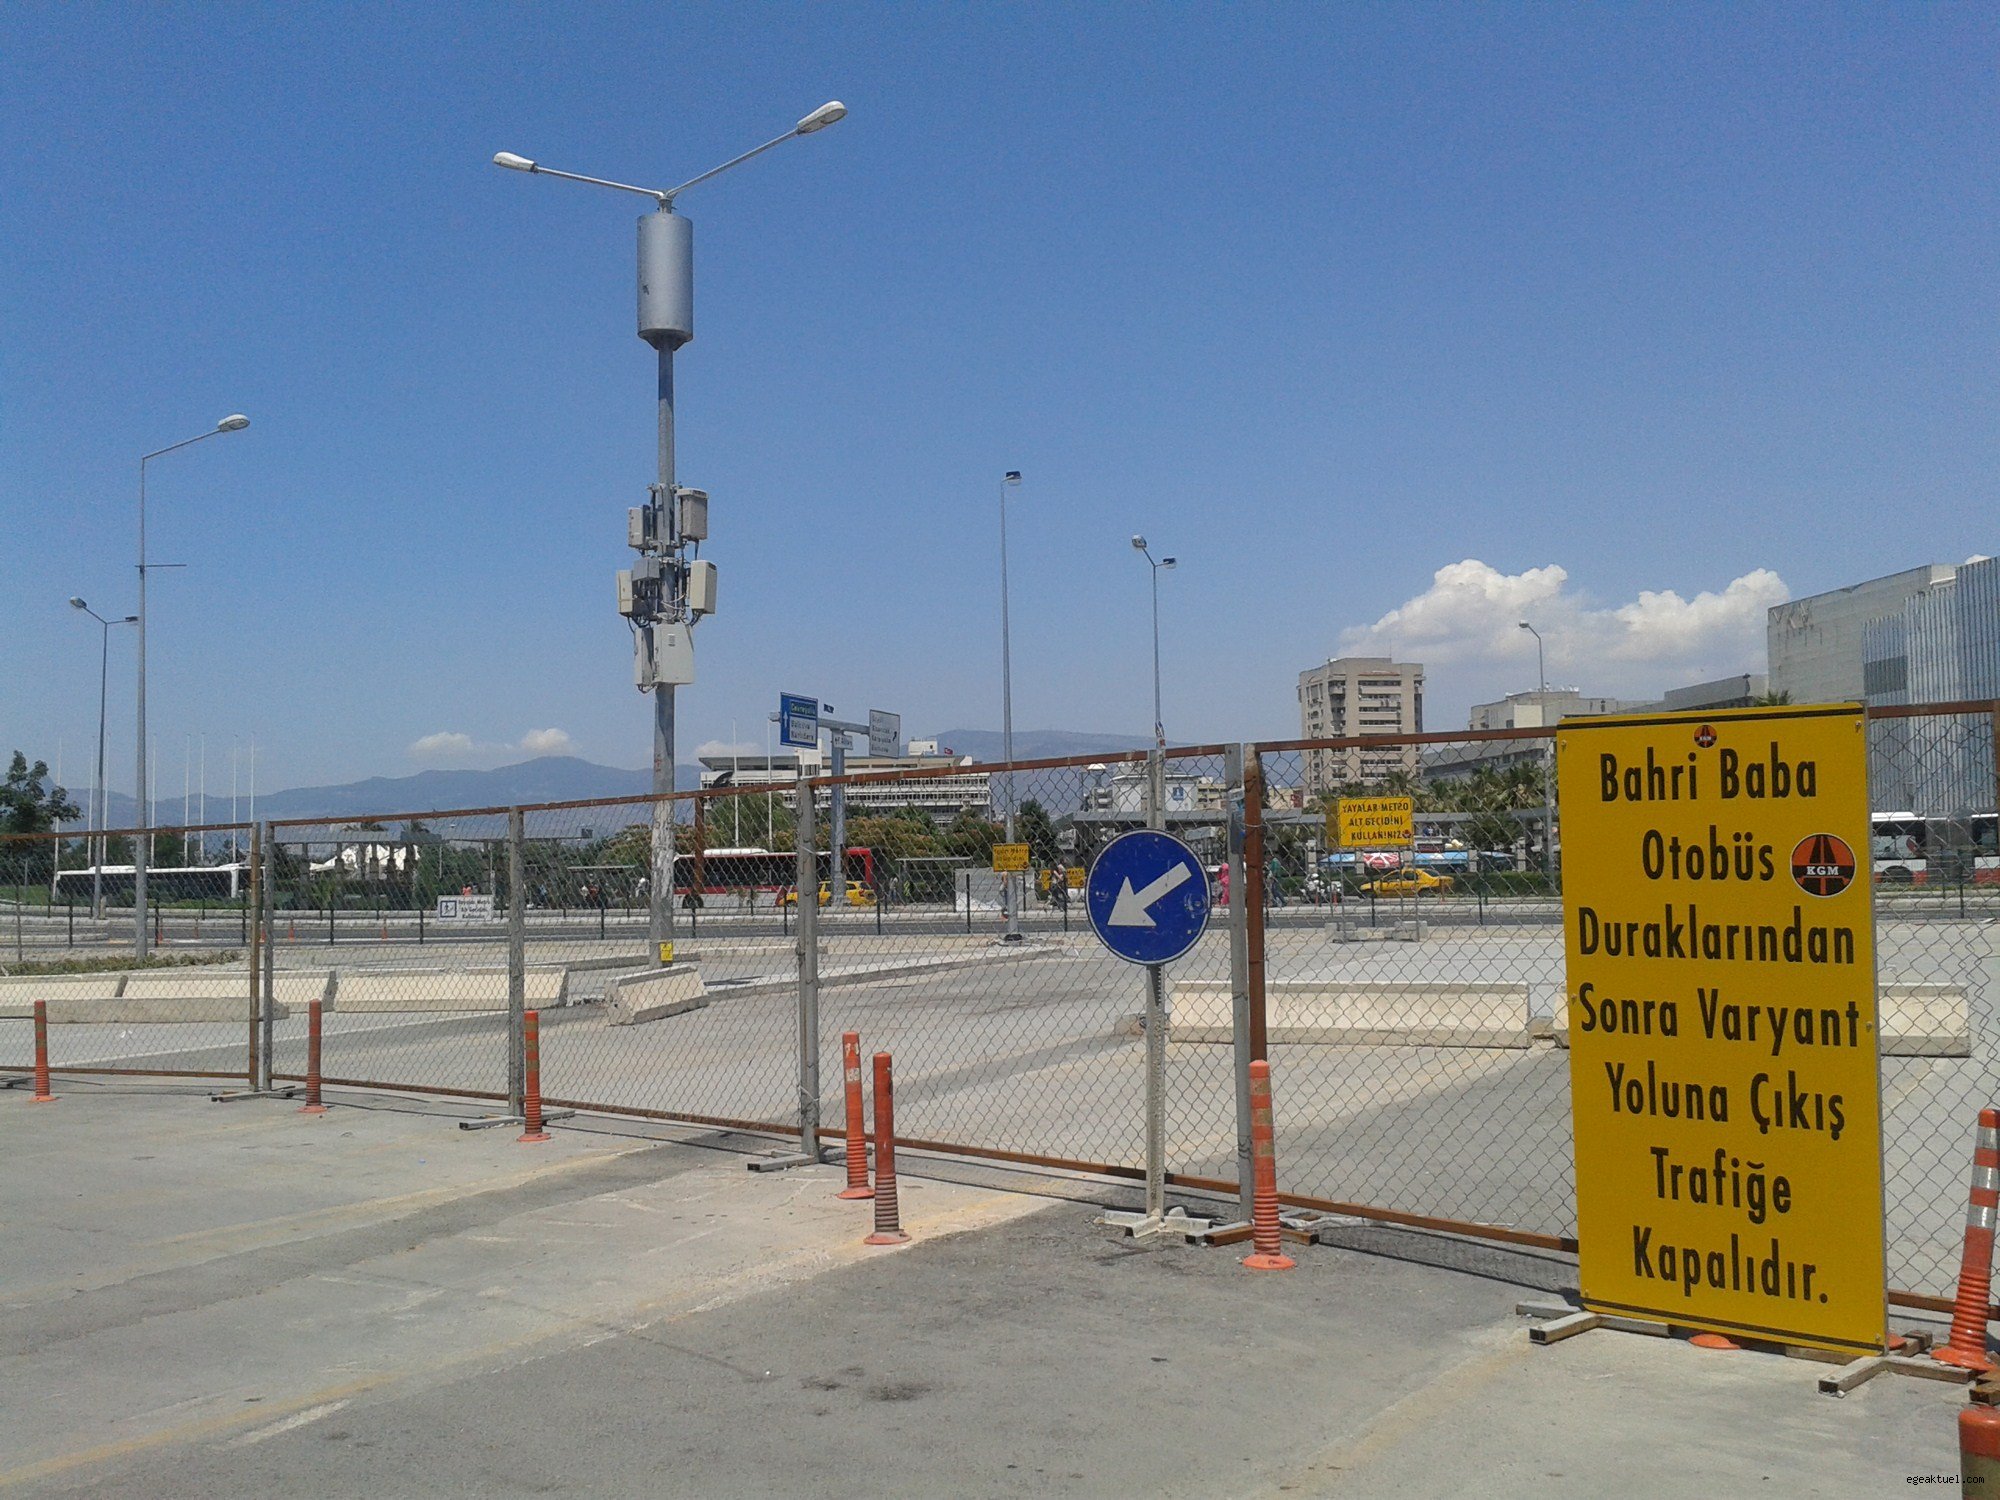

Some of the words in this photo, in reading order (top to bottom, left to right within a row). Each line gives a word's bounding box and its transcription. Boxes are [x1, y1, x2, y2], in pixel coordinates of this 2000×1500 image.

[1600, 746, 1697, 802] Bahri
[1719, 741, 1817, 799] Baba
[1342, 803, 1378, 813] YAYALAR
[1349, 817, 1363, 827] ALT
[1642, 824, 1775, 881] Otobüs
[1806, 865, 1839, 876] KGM
[1578, 904, 1854, 964] Duraklarından
[1578, 982, 1678, 1037] Sonra
[1697, 988, 1860, 1056] Varyant
[1604, 1060, 1729, 1123] Yoluna
[1750, 1070, 1845, 1141] Çıkış
[1650, 1146, 1792, 1225] Trafiğe
[1632, 1224, 1829, 1304] Kapalıdır.
